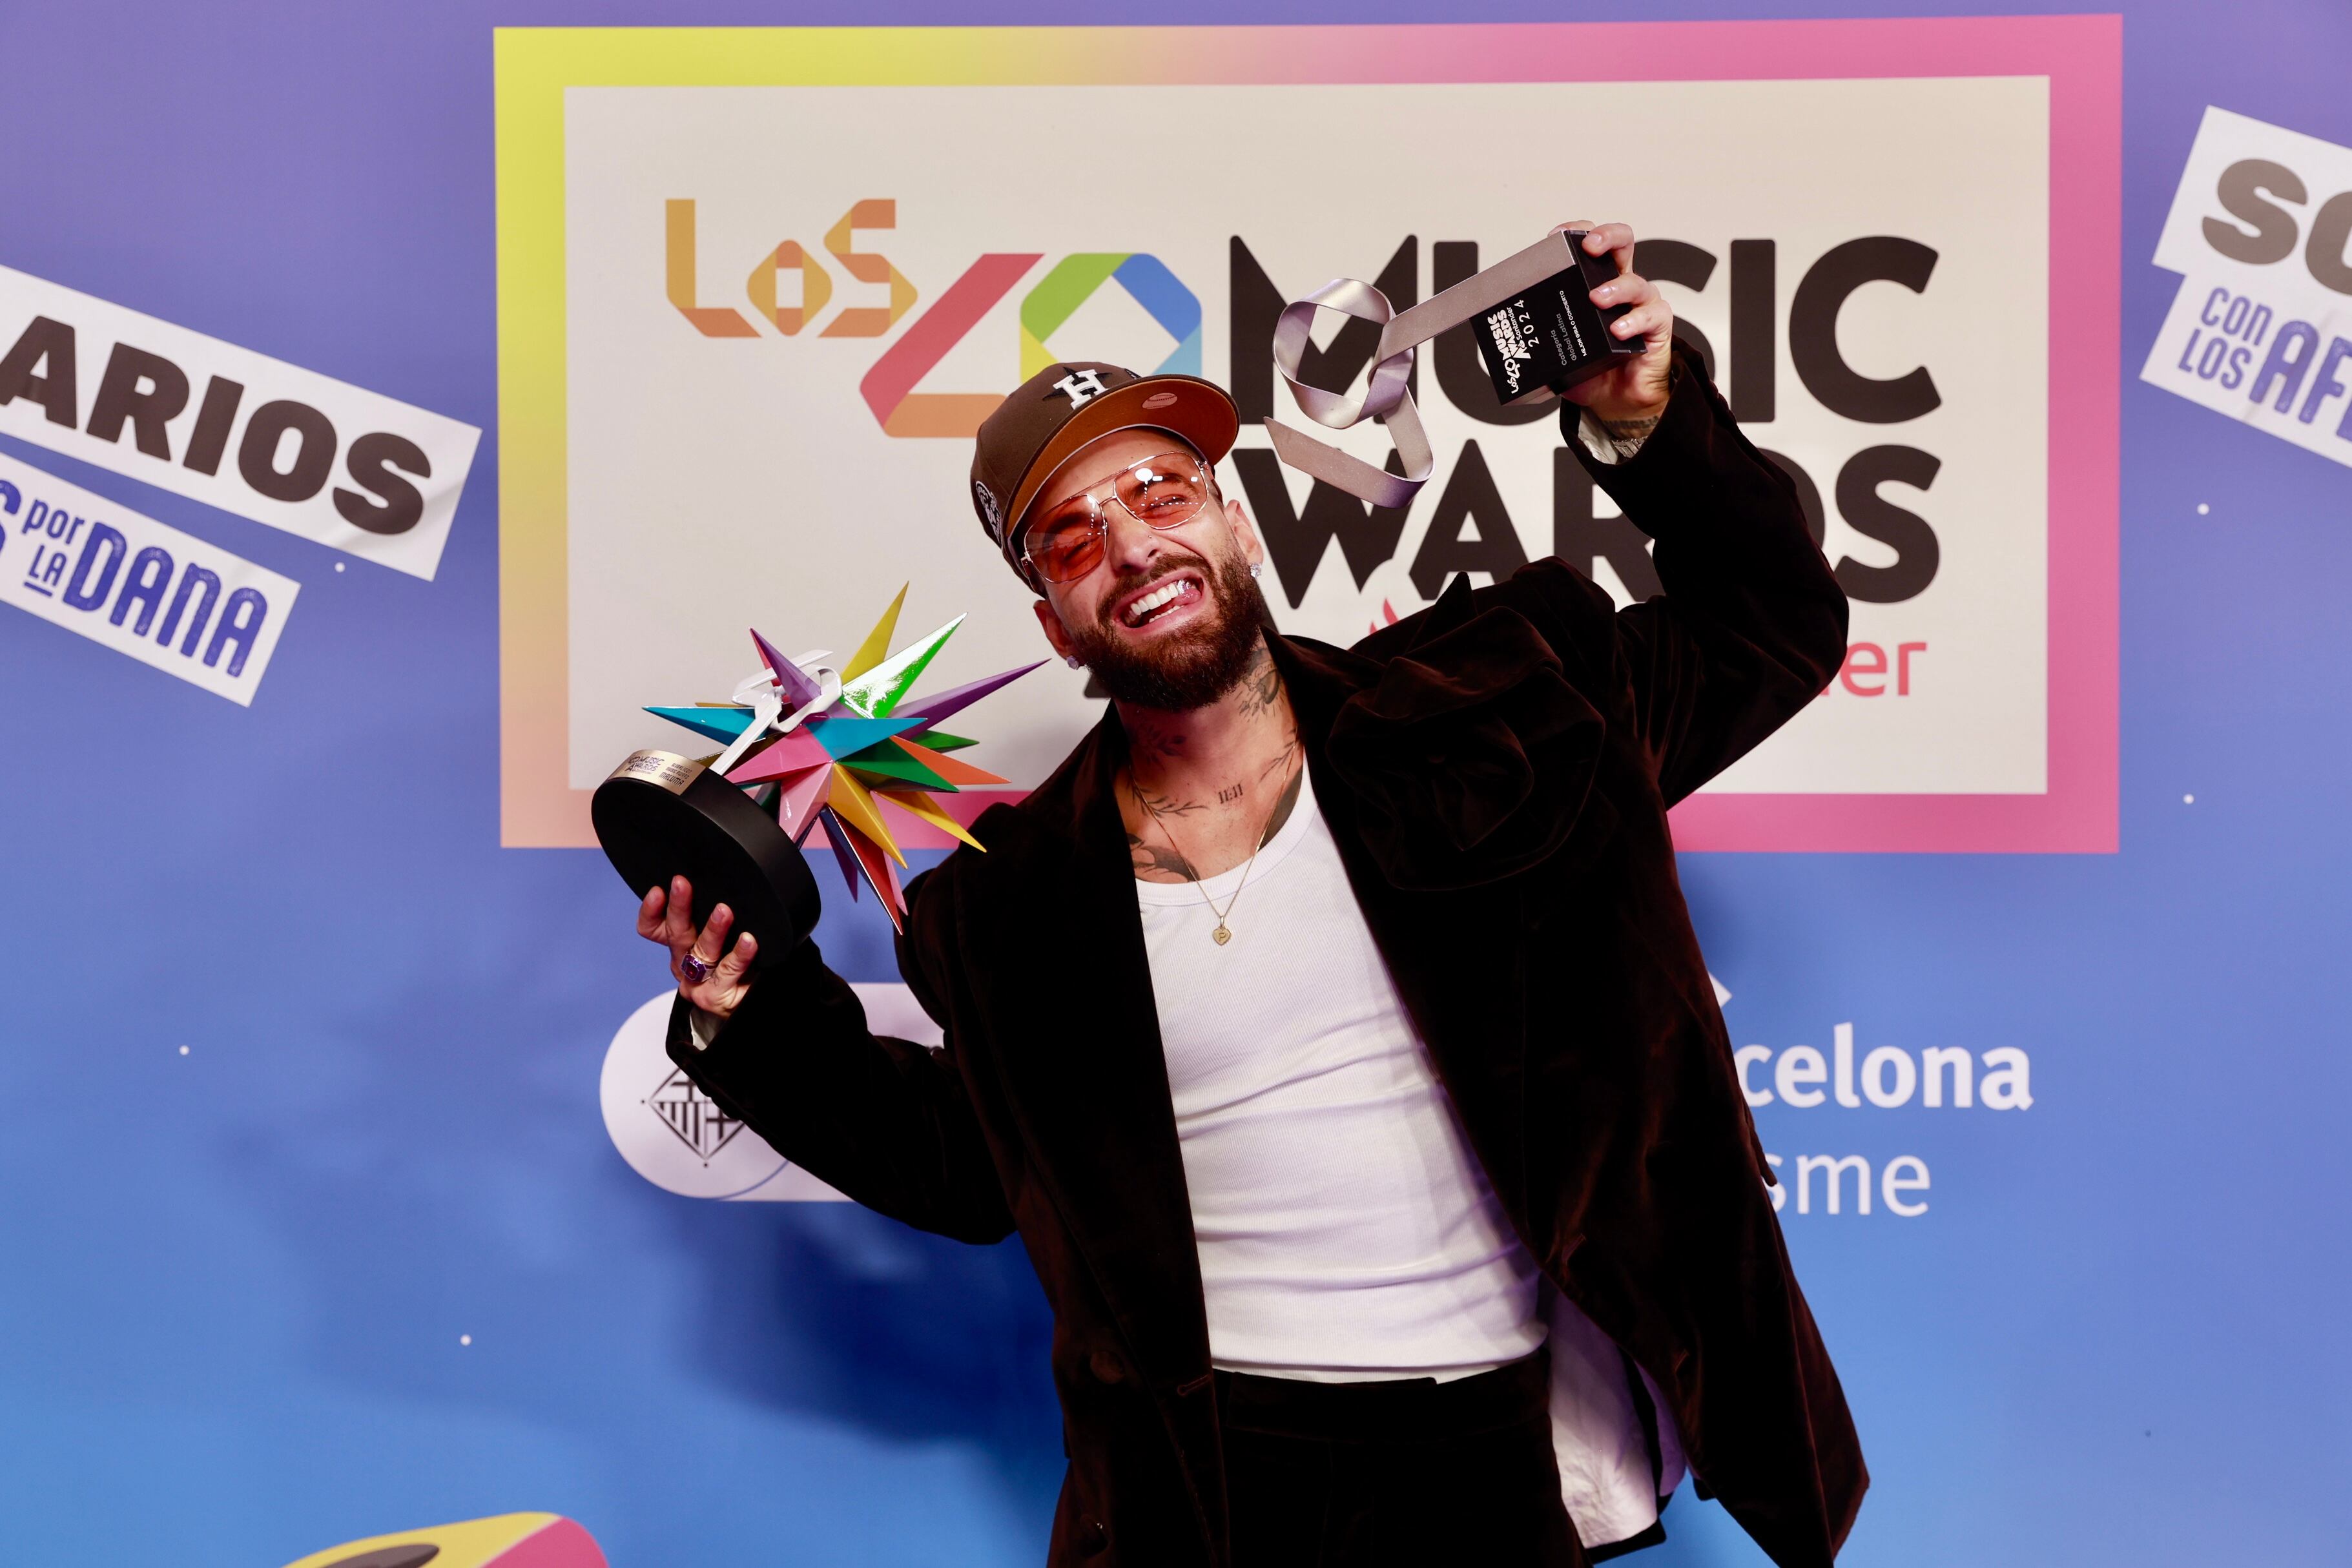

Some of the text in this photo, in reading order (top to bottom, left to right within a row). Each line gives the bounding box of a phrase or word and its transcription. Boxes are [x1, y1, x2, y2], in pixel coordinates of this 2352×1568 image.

[1507, 307, 1522, 340] Santander
[1514, 300, 1539, 347] 2024
[1559, 290, 1574, 321] CONCIERTO
[1487, 314, 1512, 360] MUSIC
[1497, 310, 1531, 359] AWARDS
[1551, 330, 1567, 366] Categoría
[1556, 313, 1577, 361] Global Latina
[1576, 338, 1587, 356] MEJOR
[1053, 369, 1109, 409] H
[2178, 320, 2352, 443] LOS AF
[0, 316, 431, 536] ARIOS
[22, 500, 85, 545] por
[1230, 438, 1939, 636] WARS
[29, 546, 67, 586] LA
[1733, 1022, 2034, 1111] celona
